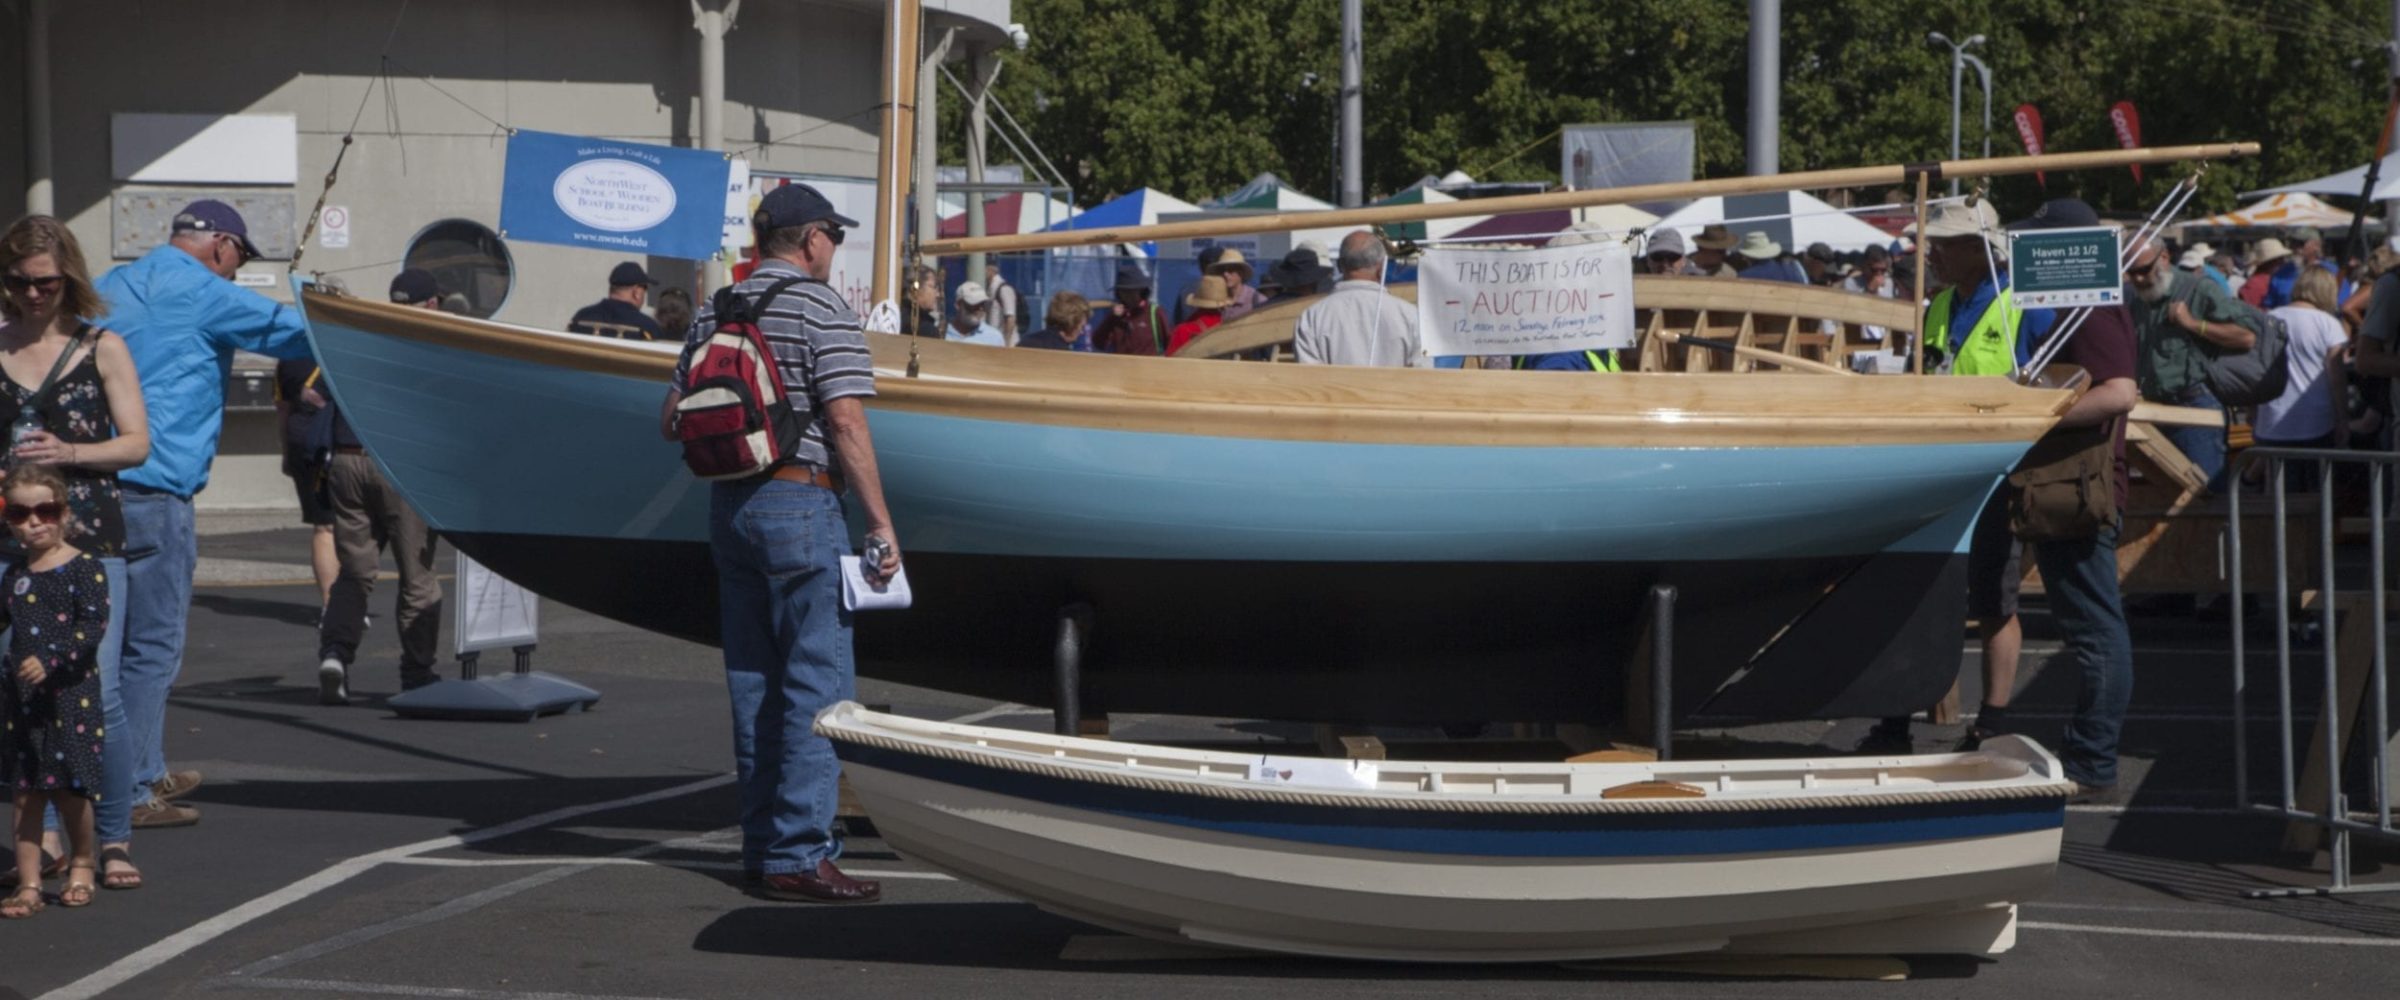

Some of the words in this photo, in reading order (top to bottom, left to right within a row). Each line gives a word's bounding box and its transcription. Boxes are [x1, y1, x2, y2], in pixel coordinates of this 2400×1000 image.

[2032, 247, 2065, 258] Haven
[2068, 245, 2080, 256] 12
[2082, 244, 2099, 255] 1/2
[1456, 261, 1500, 284] THIS
[1507, 261, 1549, 284] BOAT
[1553, 258, 1570, 280] IS
[1574, 257, 1603, 278] FOR
[1471, 288, 1588, 316] AUCTION
[1454, 318, 1471, 333] 12
[1499, 323, 1511, 332] on
